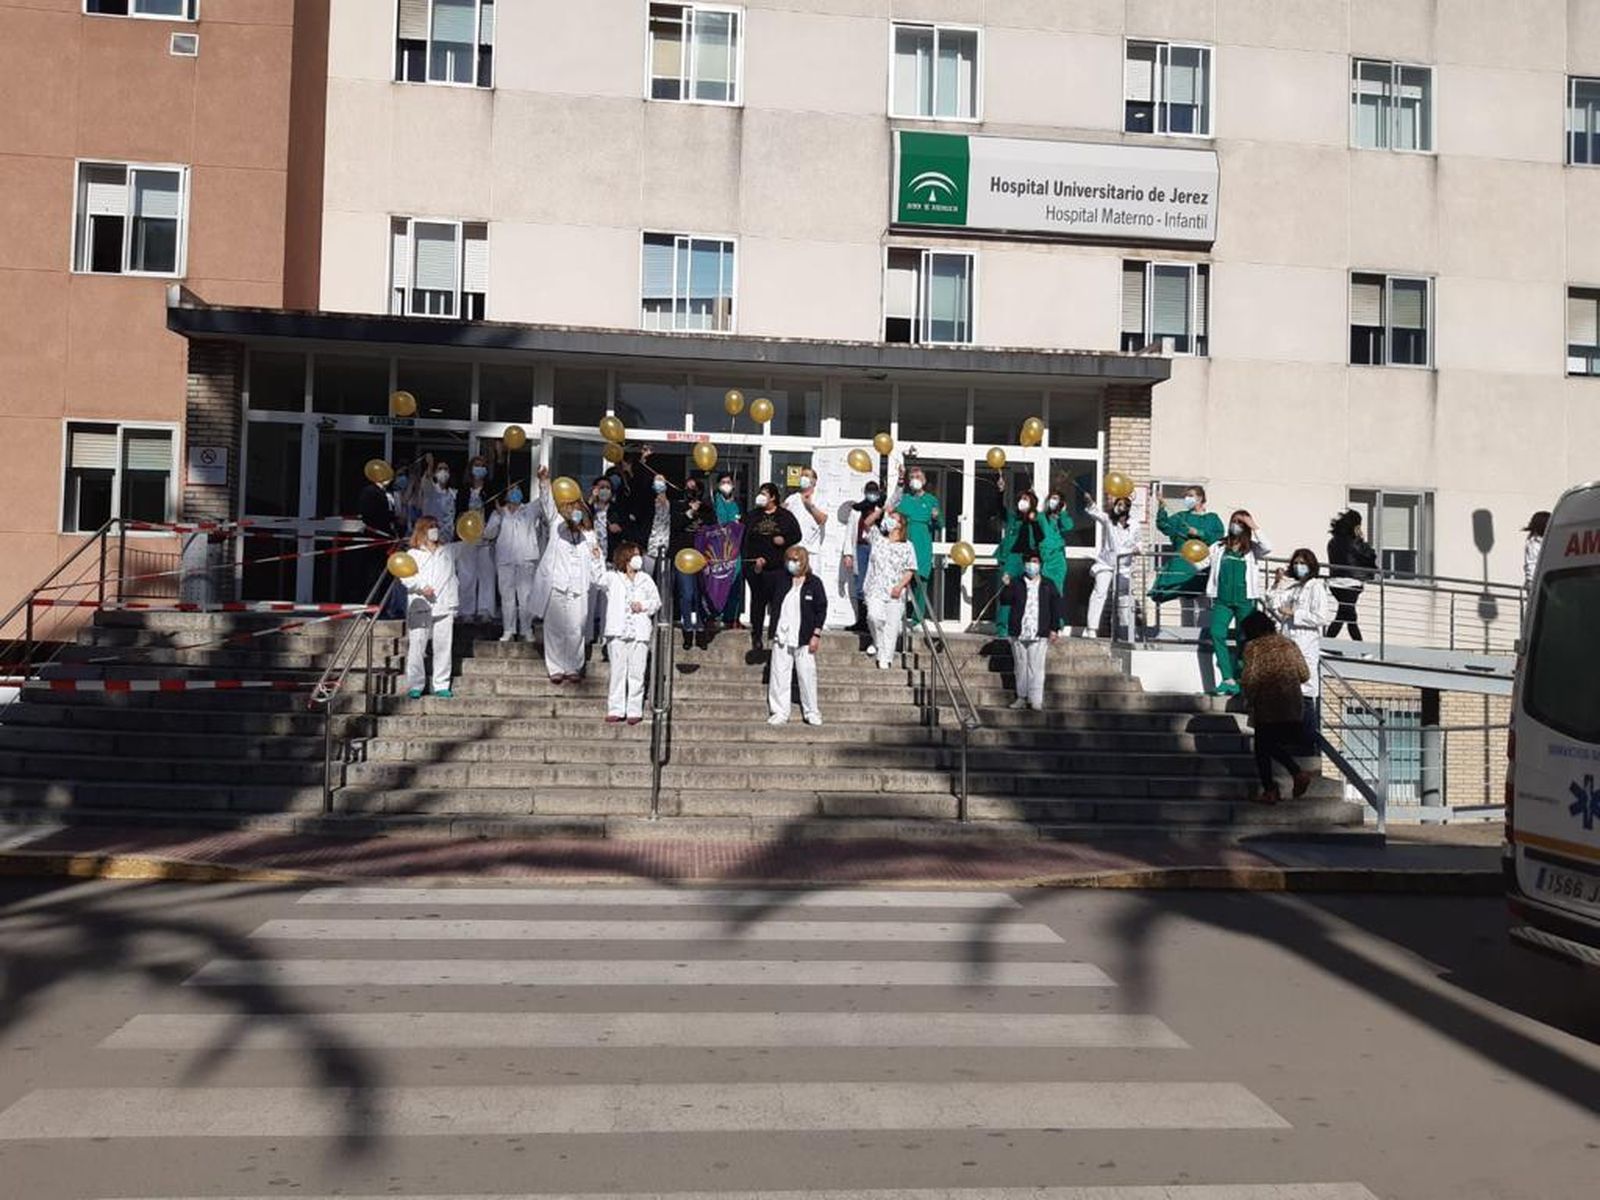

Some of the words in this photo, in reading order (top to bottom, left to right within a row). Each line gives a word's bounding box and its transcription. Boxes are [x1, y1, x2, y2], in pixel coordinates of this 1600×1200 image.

[991, 176, 1049, 197] Hospital
[1053, 180, 1144, 201] Universitario
[1148, 187, 1166, 202] de
[1169, 188, 1209, 205] Jerez
[1046, 205, 1098, 224] Hospital
[1101, 208, 1154, 226] Materno
[1165, 211, 1208, 229] Infantil
